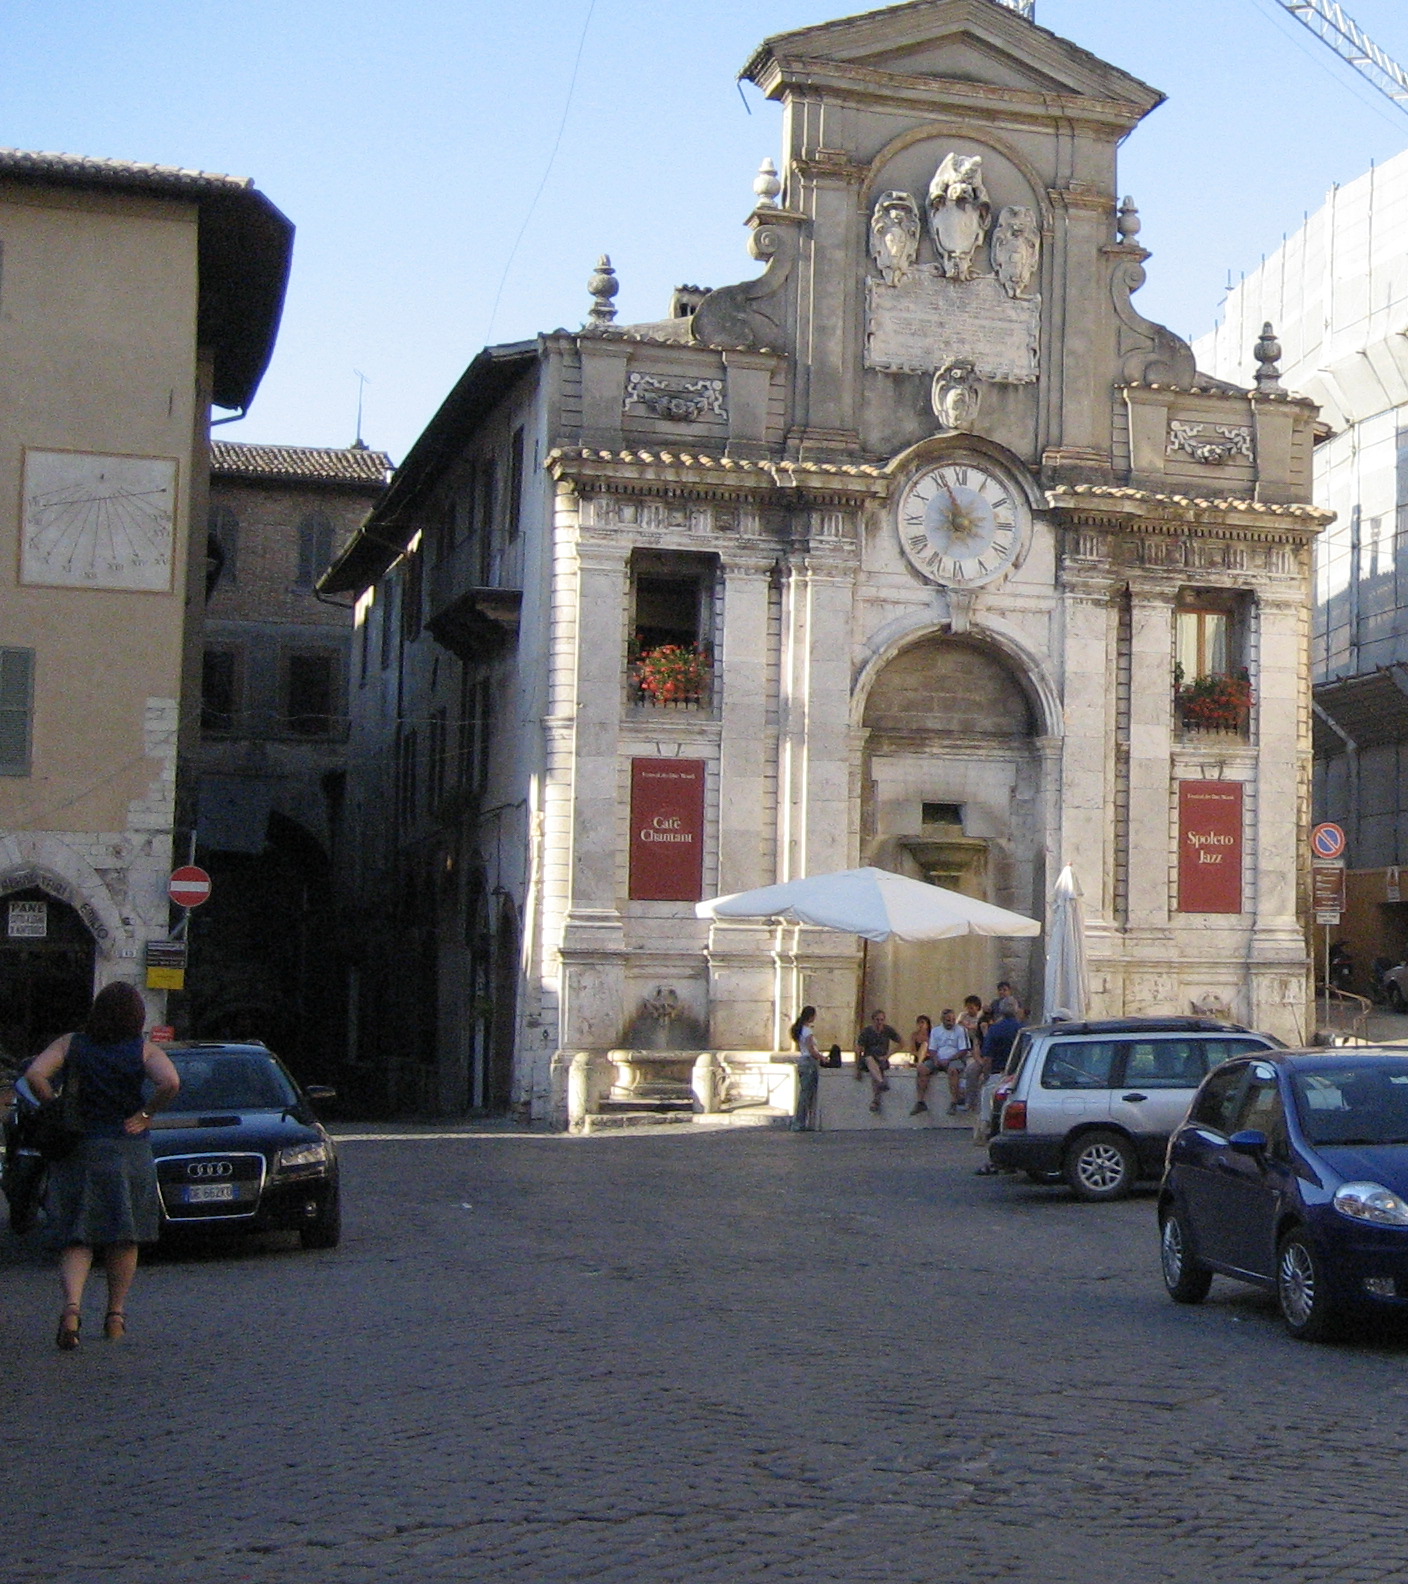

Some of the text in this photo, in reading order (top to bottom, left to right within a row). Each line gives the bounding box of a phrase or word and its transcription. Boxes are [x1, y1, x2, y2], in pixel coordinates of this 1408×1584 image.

[1187, 830, 1235, 848] Spoleto
[1198, 849, 1222, 864] Jazz
[11, 903, 45, 913] PANE
